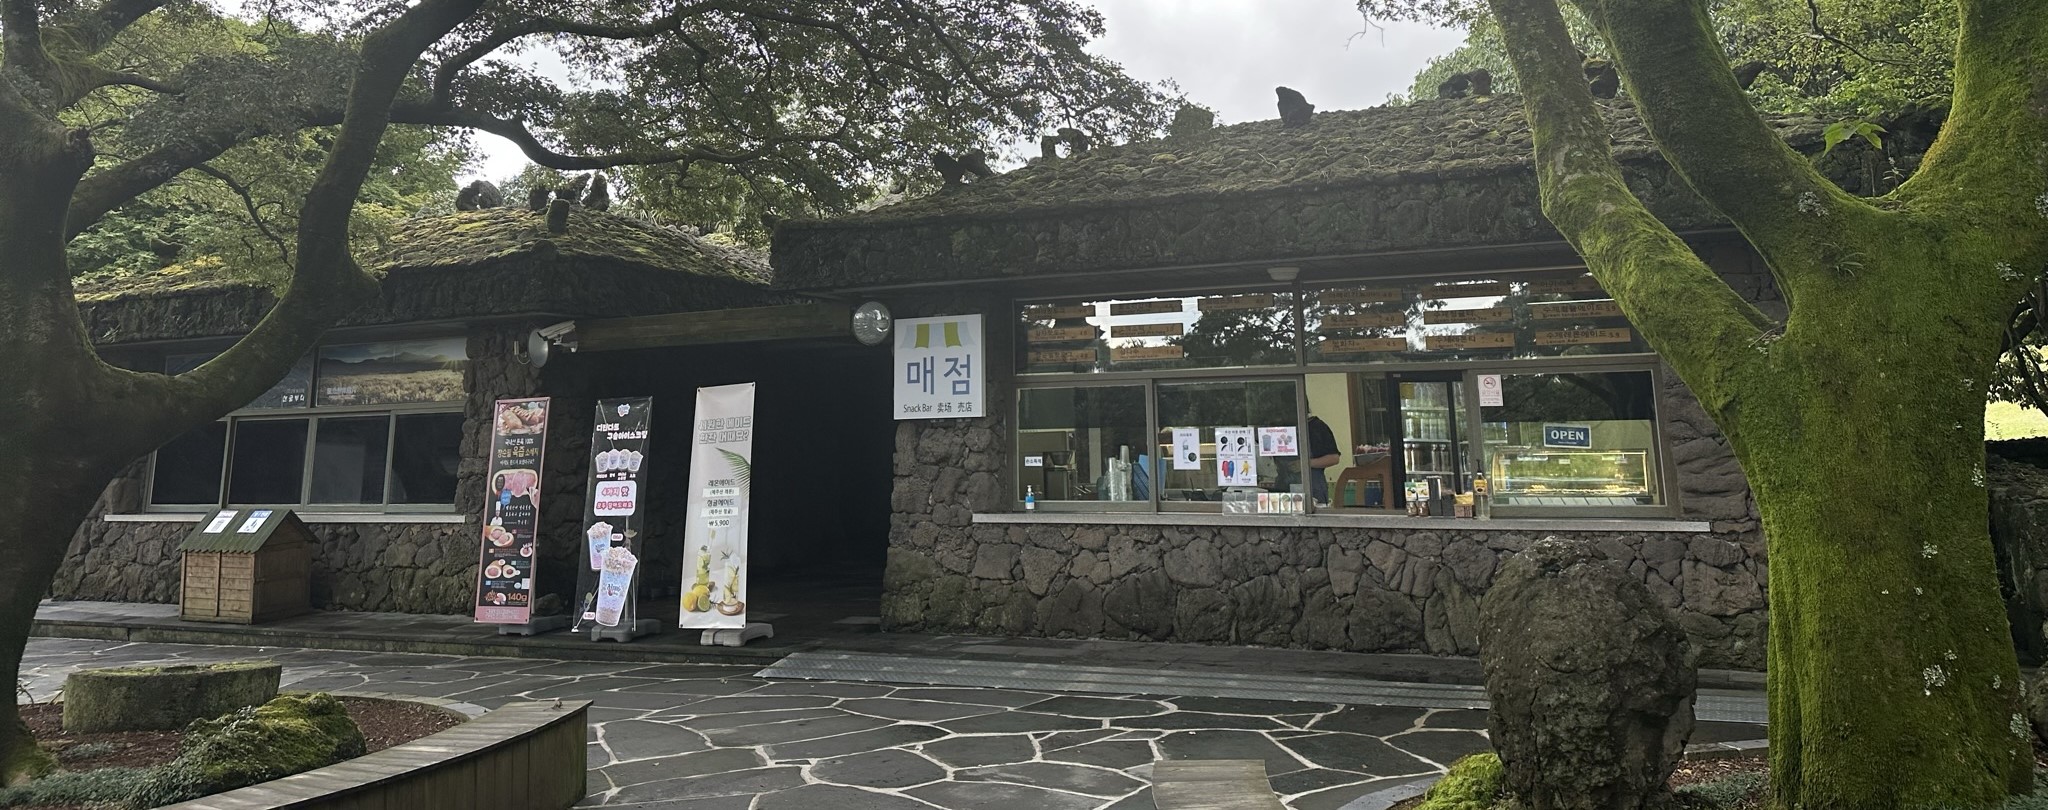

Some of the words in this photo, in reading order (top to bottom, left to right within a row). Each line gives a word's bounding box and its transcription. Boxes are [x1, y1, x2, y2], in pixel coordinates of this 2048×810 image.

[907, 354, 971, 396] 매점
[903, 404, 921, 413] Snack
[922, 403, 932, 413] Bar
[698, 418, 725, 431] 시원한
[726, 416, 751, 429] 에이드
[606, 430, 648, 440] 구슬아이스크림
[1551, 430, 1584, 440] OPEN
[708, 479, 735, 487] 레몬에이드
[601, 486, 620, 497] 4가지
[507, 593, 528, 602] 140g
